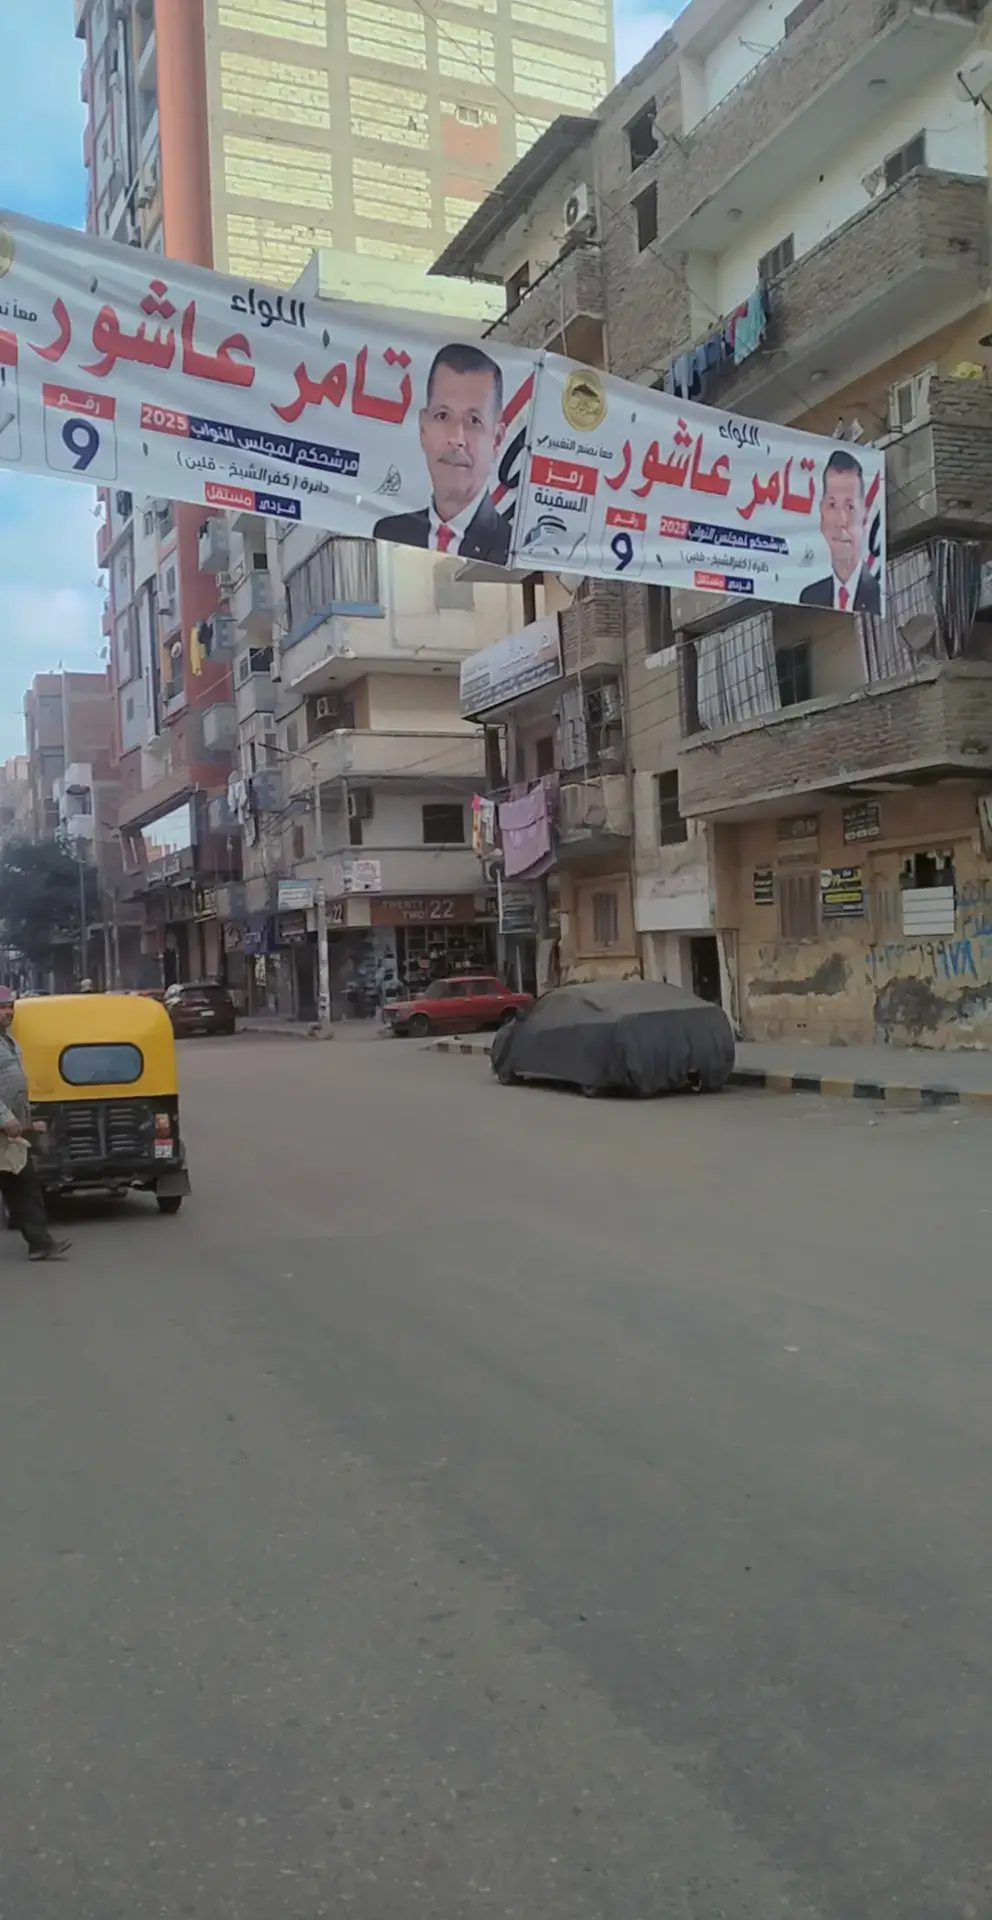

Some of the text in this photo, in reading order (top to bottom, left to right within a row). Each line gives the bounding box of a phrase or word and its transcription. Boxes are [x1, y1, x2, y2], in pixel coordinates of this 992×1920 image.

[230, 287, 305, 328] اللواء
[27, 279, 413, 424] تامر عاشور
[61, 417, 100, 471] 9
[141, 406, 359, 472] مرشحكم لمجلس النواب 2025
[719, 418, 760, 448] اللواء
[546, 461, 584, 490] رمز
[604, 416, 731, 498] عاشور
[206, 485, 253, 506] مستقل
[534, 487, 588, 513] السفينة
[736, 456, 816, 520] تامر
[660, 518, 687, 534] 2025
[611, 532, 633, 571] 9
[430, 900, 455, 919] 22
